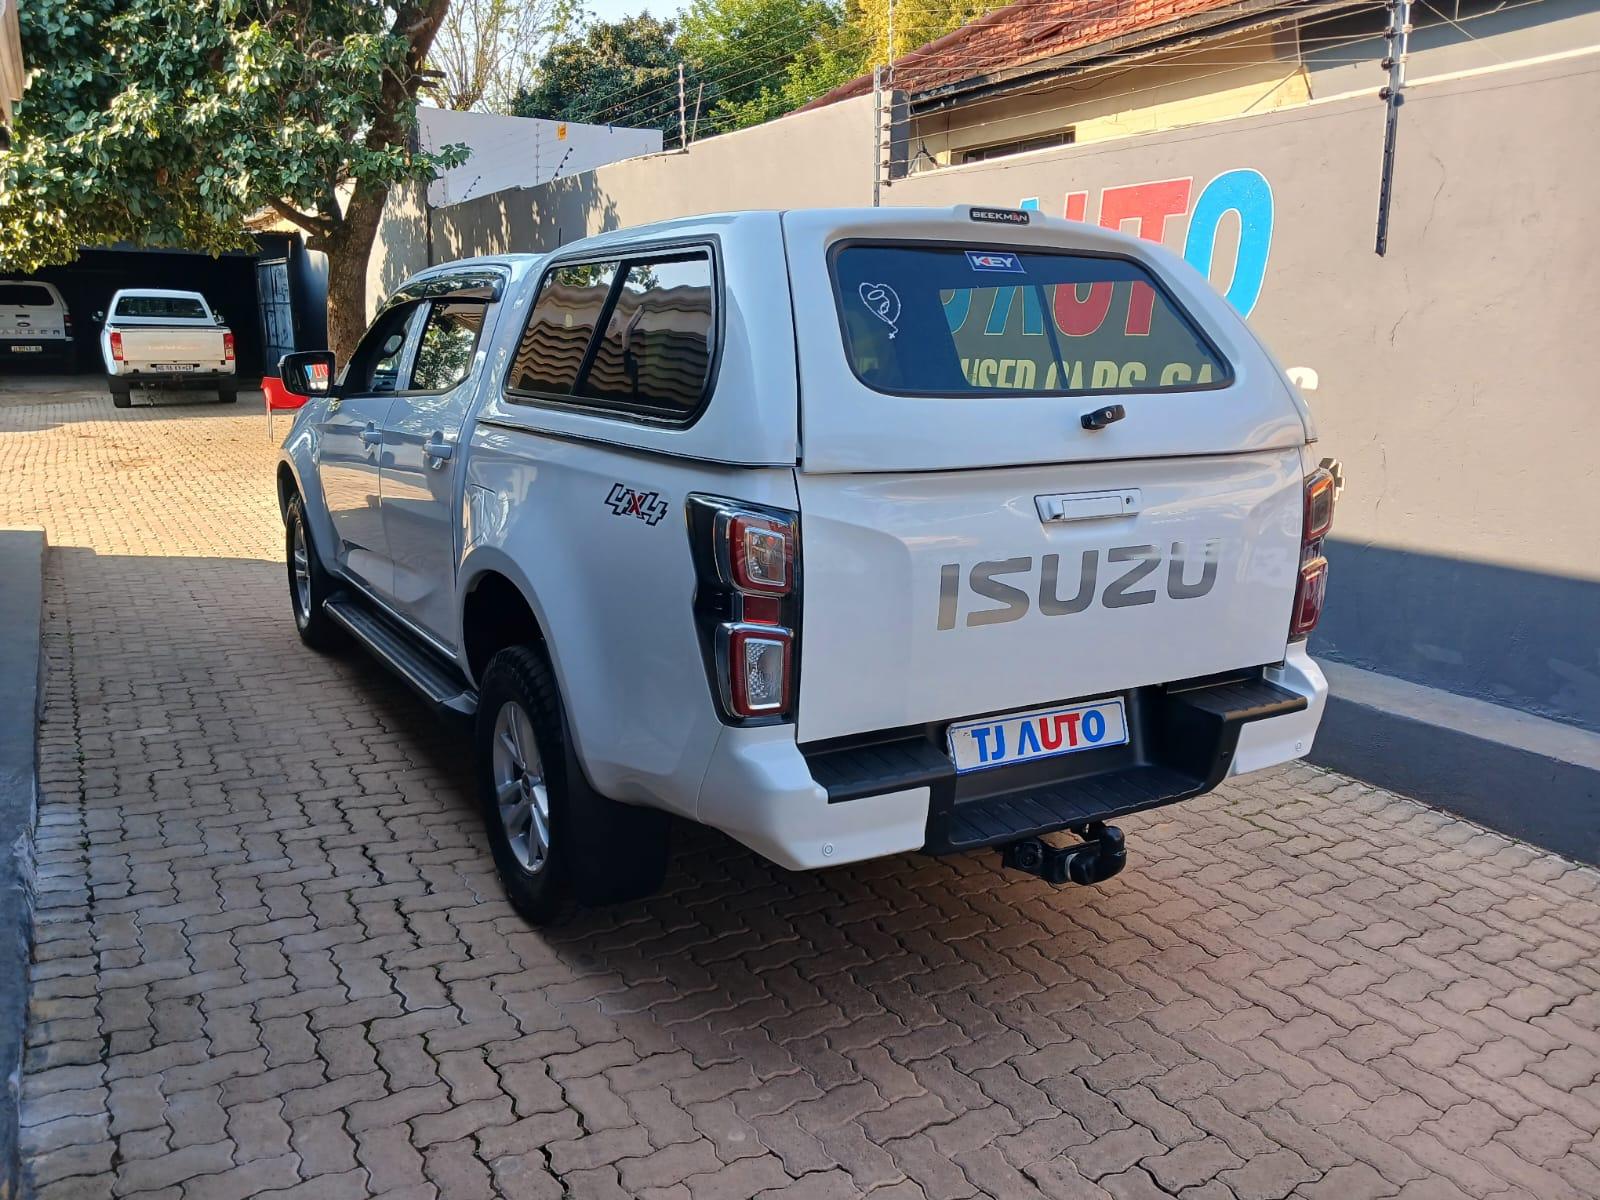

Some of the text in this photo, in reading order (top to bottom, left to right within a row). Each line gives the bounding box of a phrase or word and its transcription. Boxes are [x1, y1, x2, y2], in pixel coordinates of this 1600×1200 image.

[972, 210, 1028, 222] BEEKMAN
[971, 255, 1013, 268] KEY
[937, 537, 1220, 631] ISUZU
[971, 709, 1106, 763] TJ AUTO
